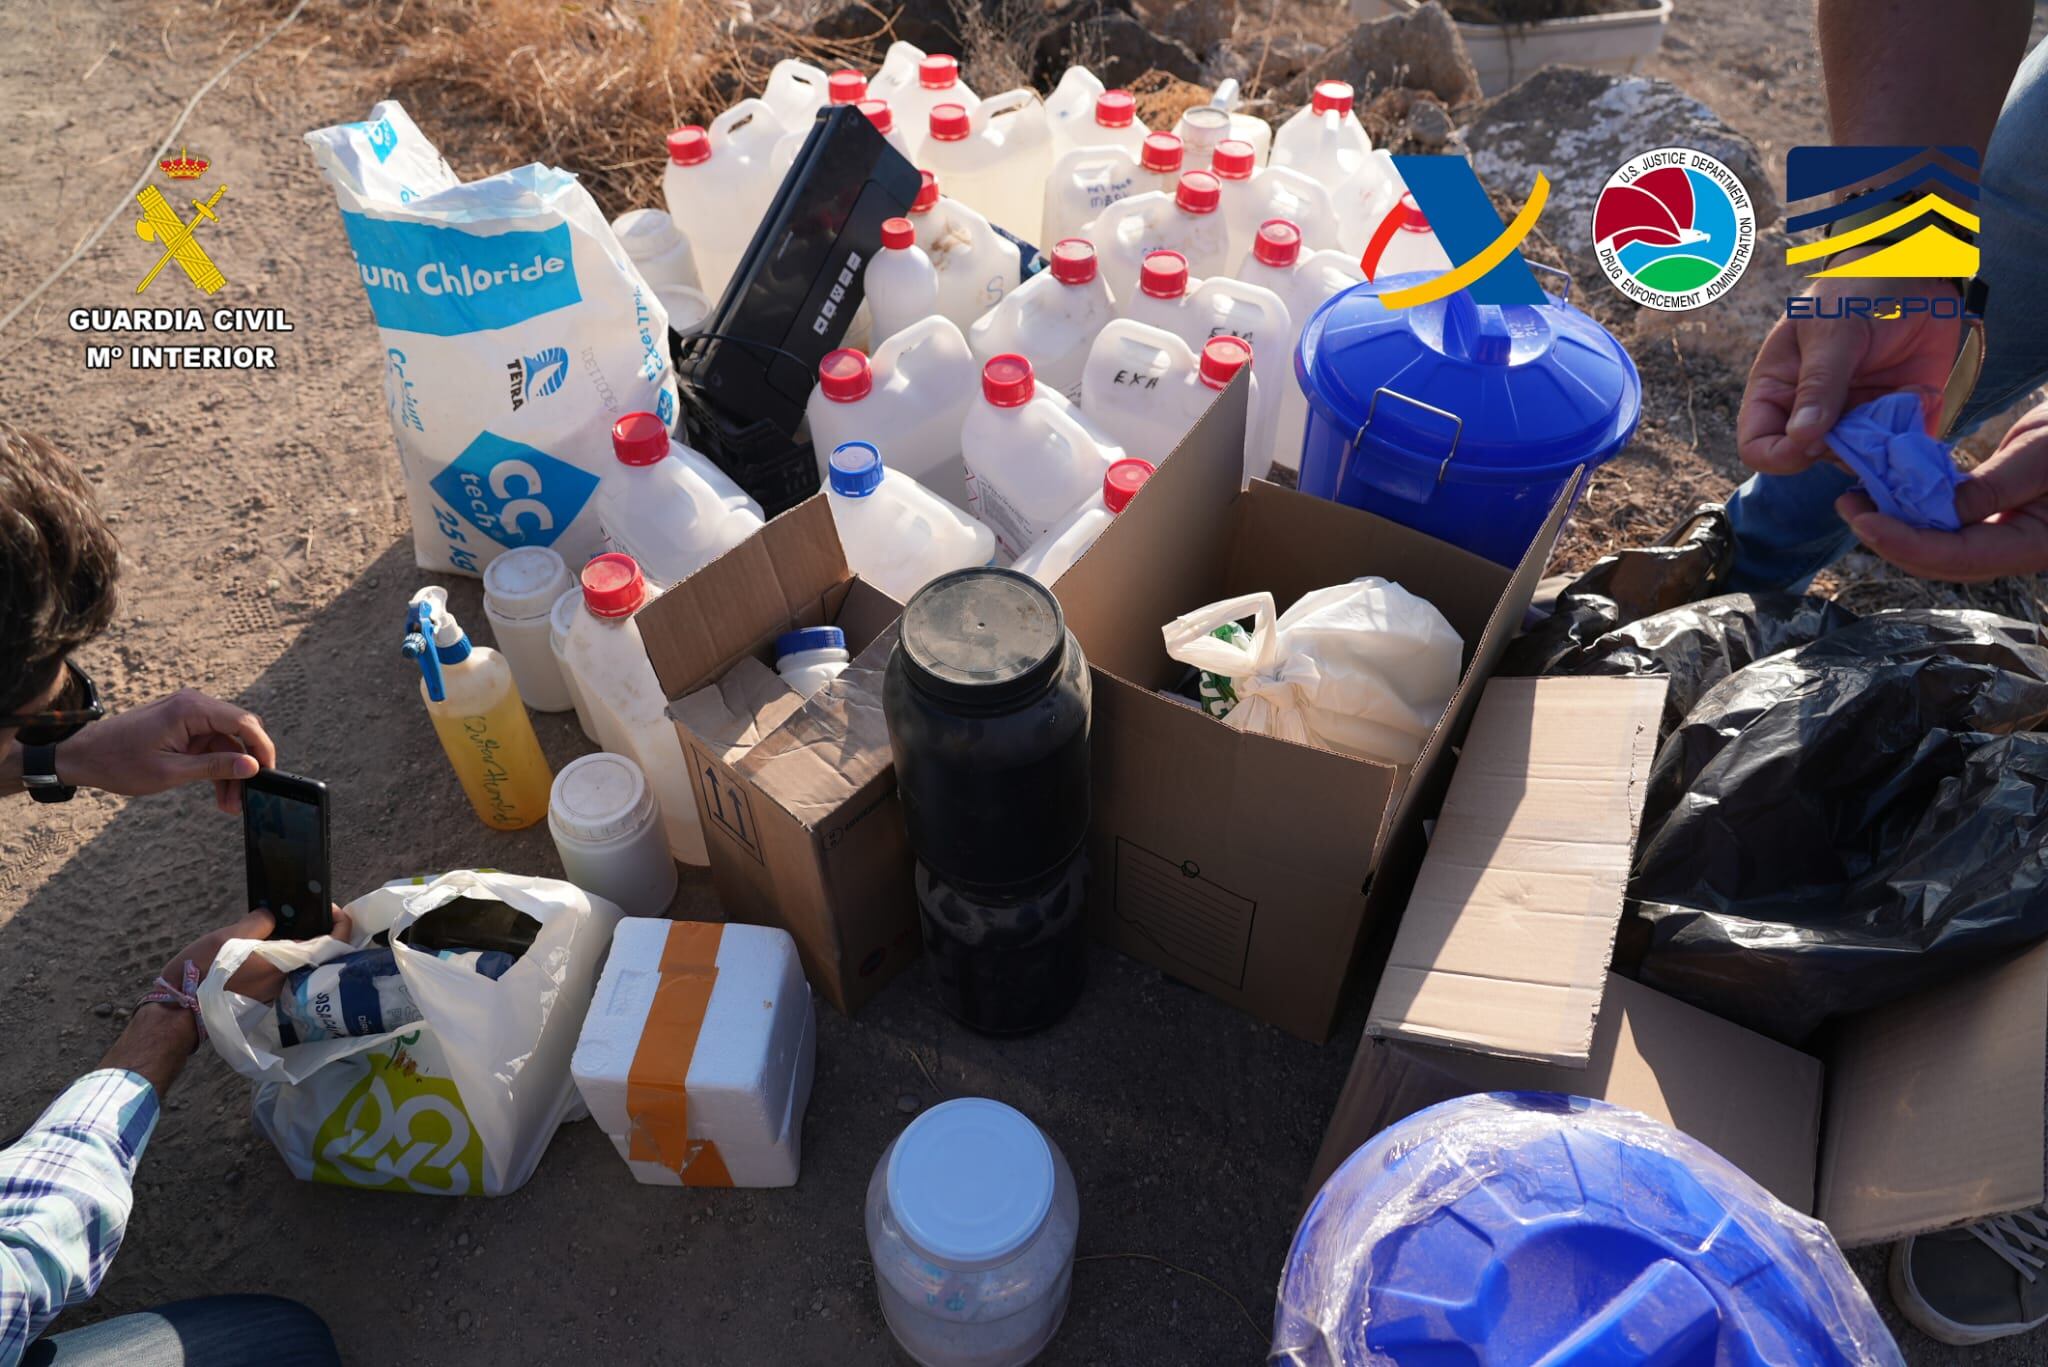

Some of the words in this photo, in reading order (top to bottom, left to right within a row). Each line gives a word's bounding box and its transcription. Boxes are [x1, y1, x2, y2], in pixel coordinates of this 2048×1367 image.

[416, 255, 566, 297] Chloride
[507, 358, 525, 412] TETRA
[488, 459, 554, 535] CC
[432, 504, 467, 544] 25
